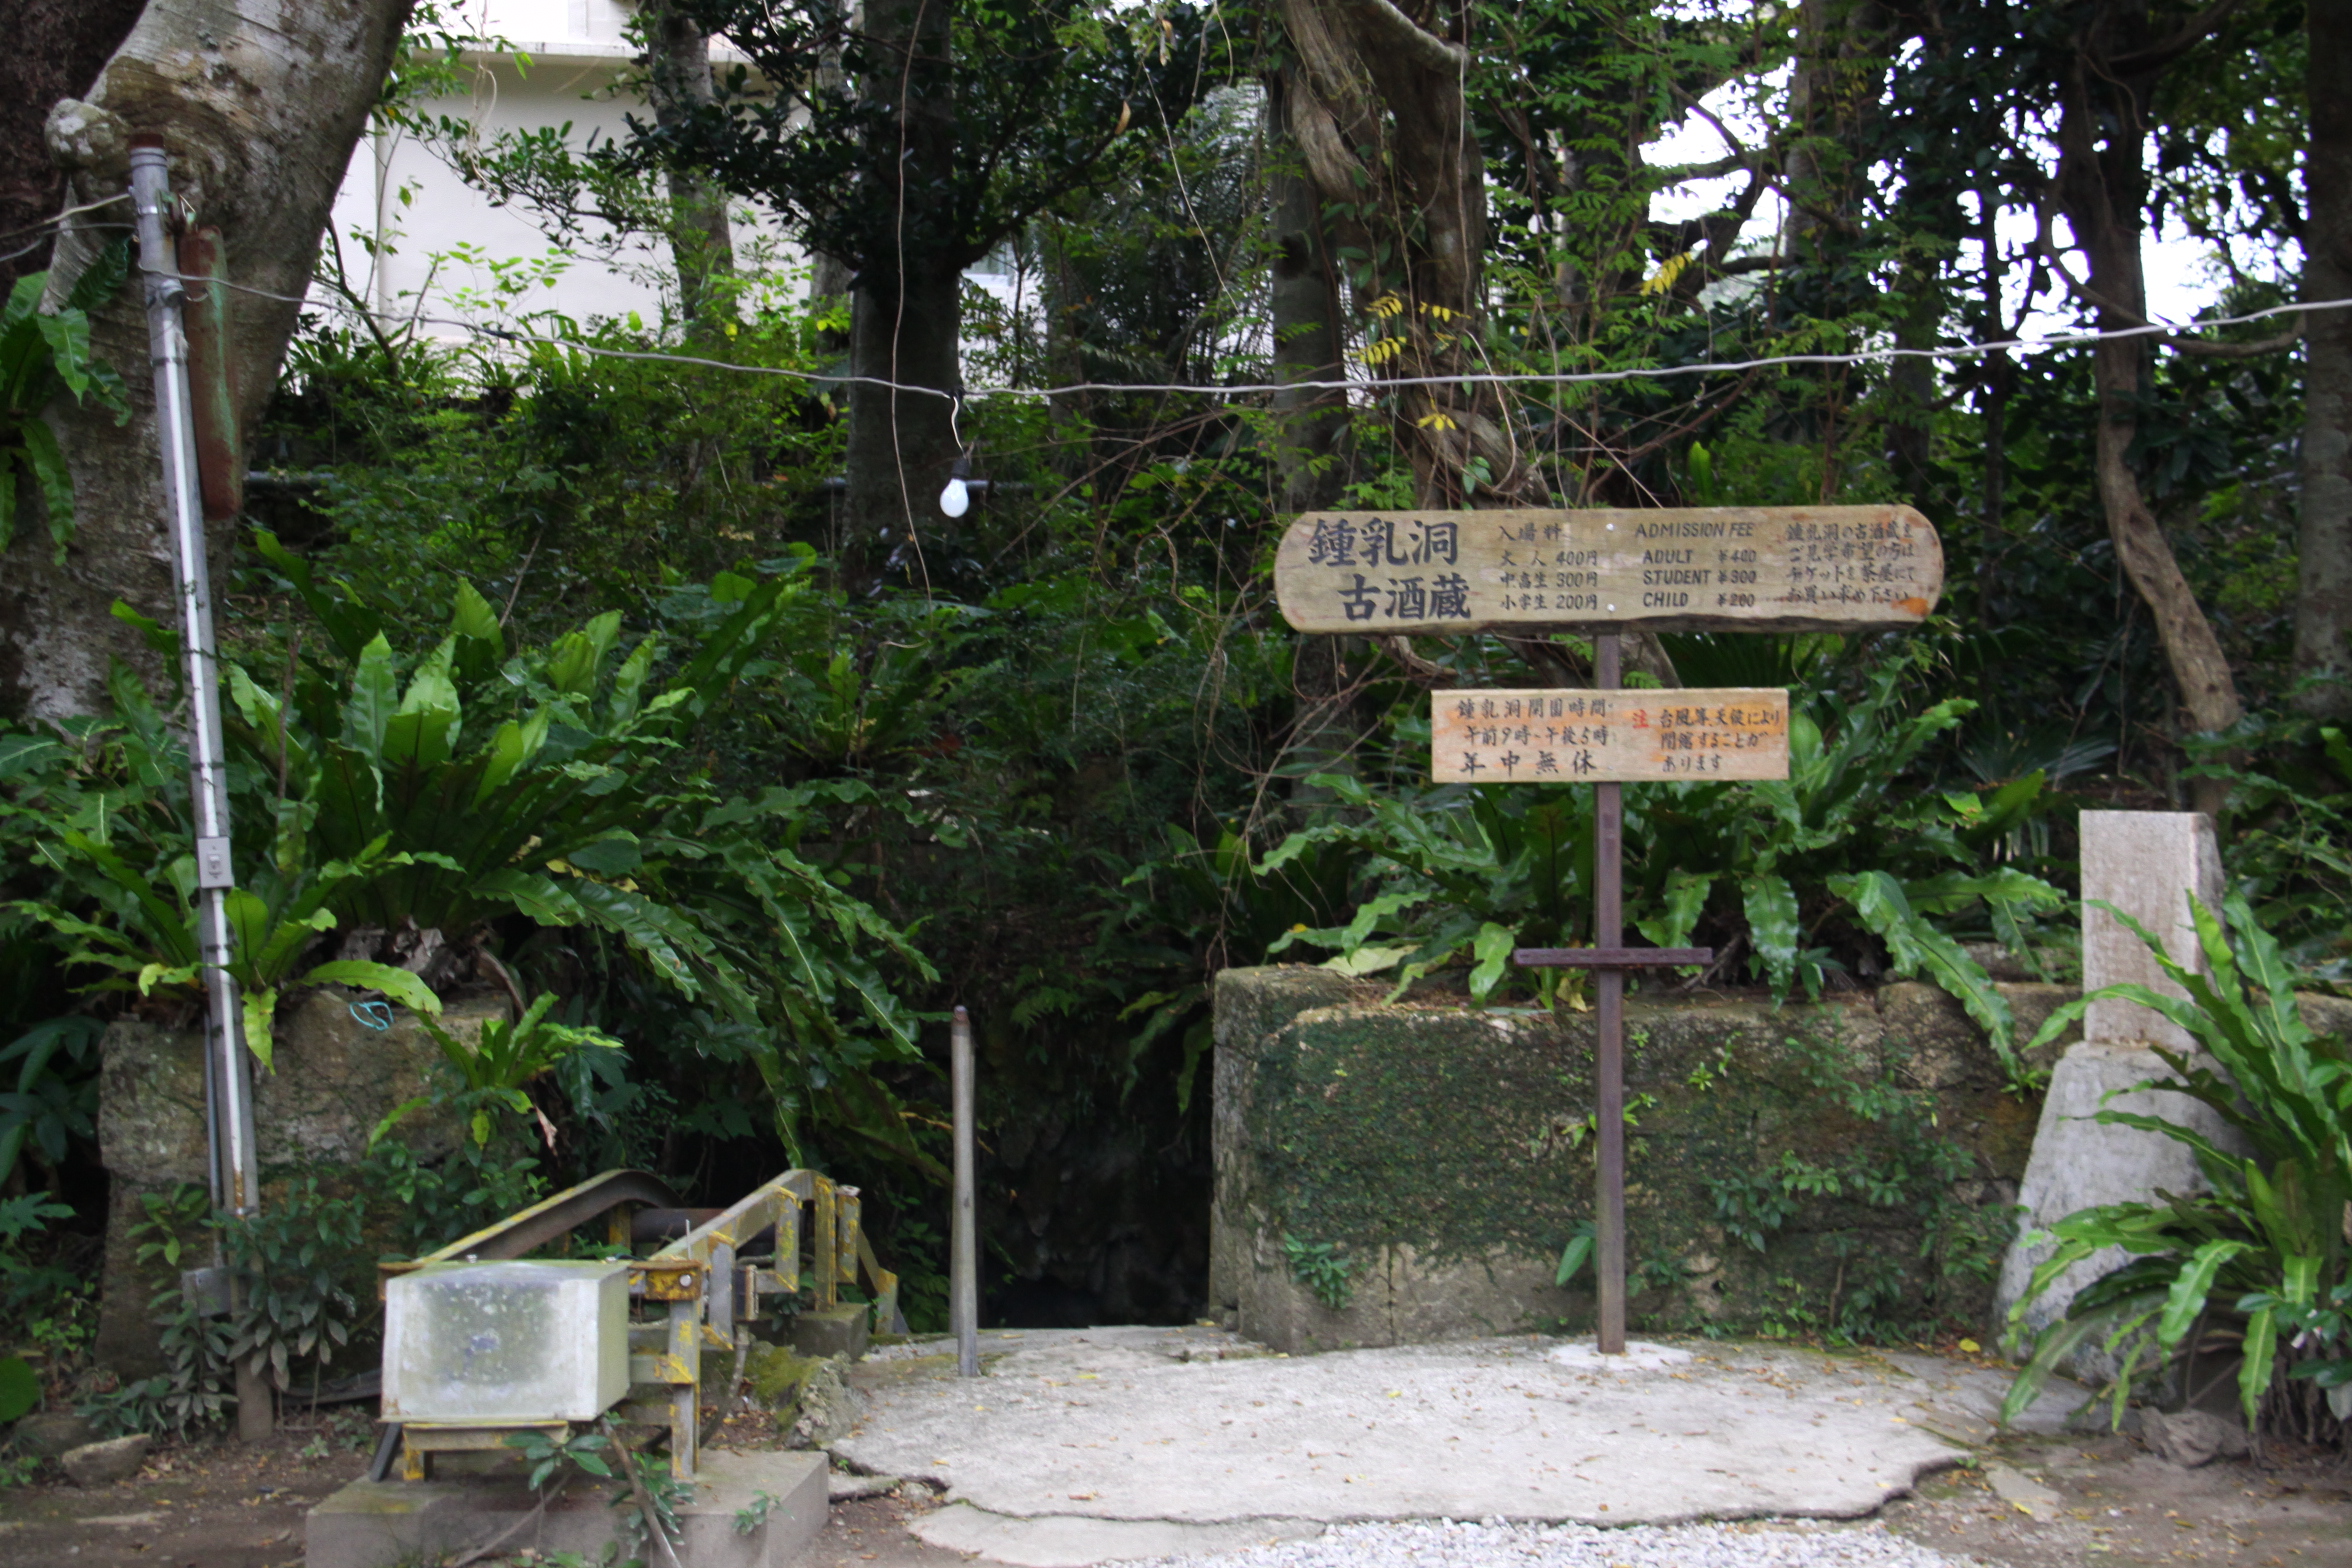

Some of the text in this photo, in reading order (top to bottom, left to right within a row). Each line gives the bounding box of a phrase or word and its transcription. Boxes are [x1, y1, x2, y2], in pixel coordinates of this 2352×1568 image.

[1635, 522, 1756, 538] ADMISSION FEE
[1500, 550, 1598, 567] 大人 400円
[1643, 549, 1693, 564] ADULT
[1500, 571, 1598, 589] 中高生 300円
[1643, 569, 1711, 585] STUDENT
[1337, 572, 1471, 620] 古酒蔵
[1500, 593, 1598, 610] 小学生 200円
[1643, 591, 1689, 608] CHILD
[1632, 709, 1650, 729] 注
[1459, 749, 1597, 778] 年中無休
[1663, 754, 1722, 772] あります
